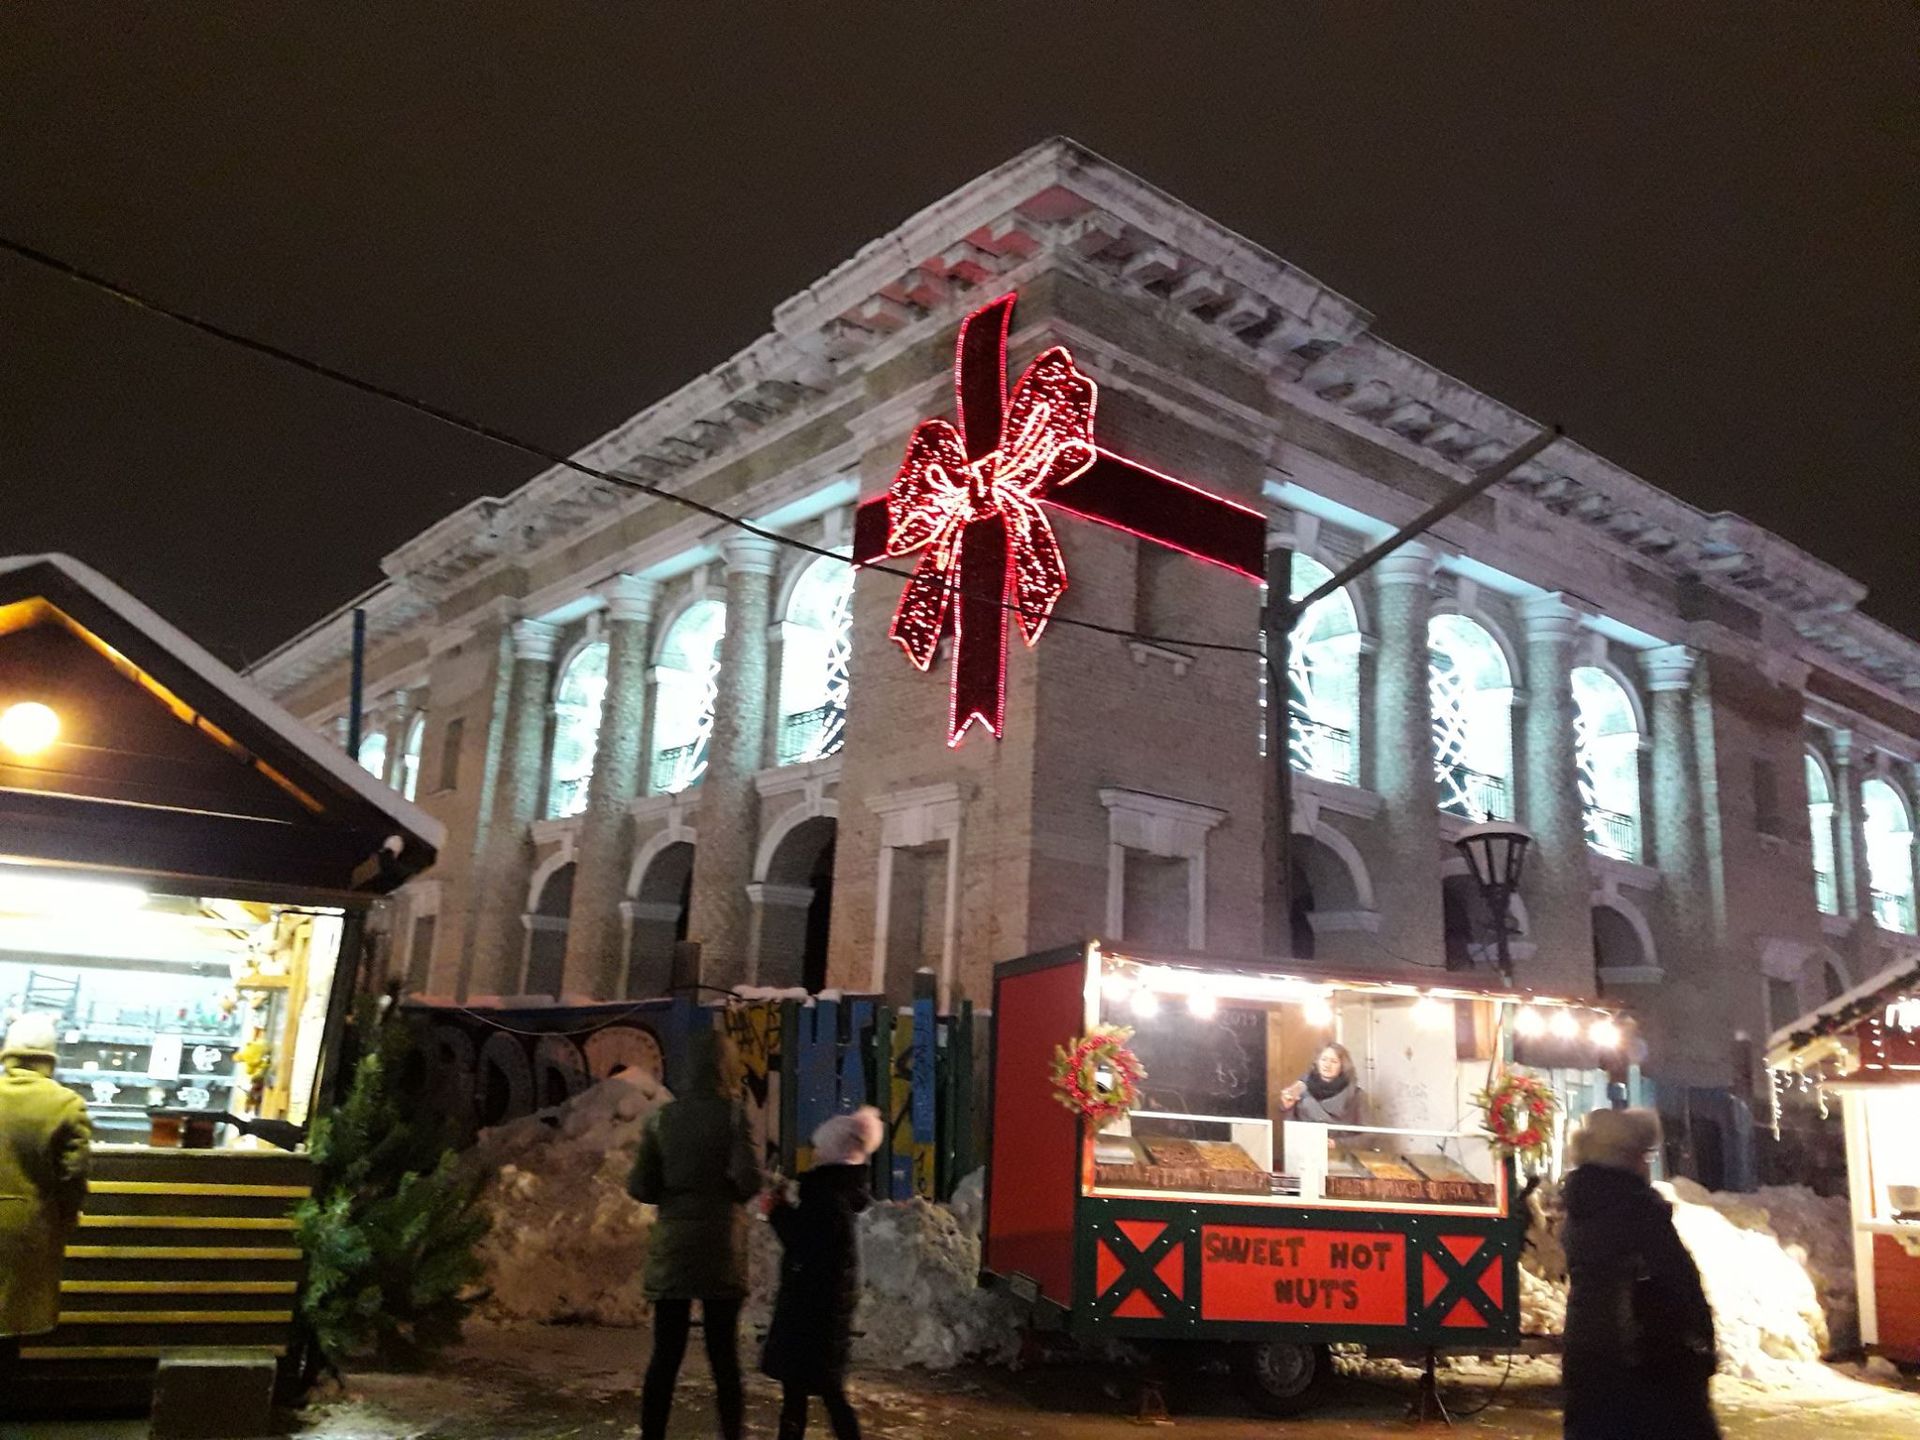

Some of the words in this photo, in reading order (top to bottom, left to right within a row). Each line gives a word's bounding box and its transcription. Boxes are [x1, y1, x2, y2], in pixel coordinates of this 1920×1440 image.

[1205, 1232, 1304, 1267] SWEET
[1329, 1242, 1392, 1272] HOT
[1274, 1278, 1359, 1310] NUTS
